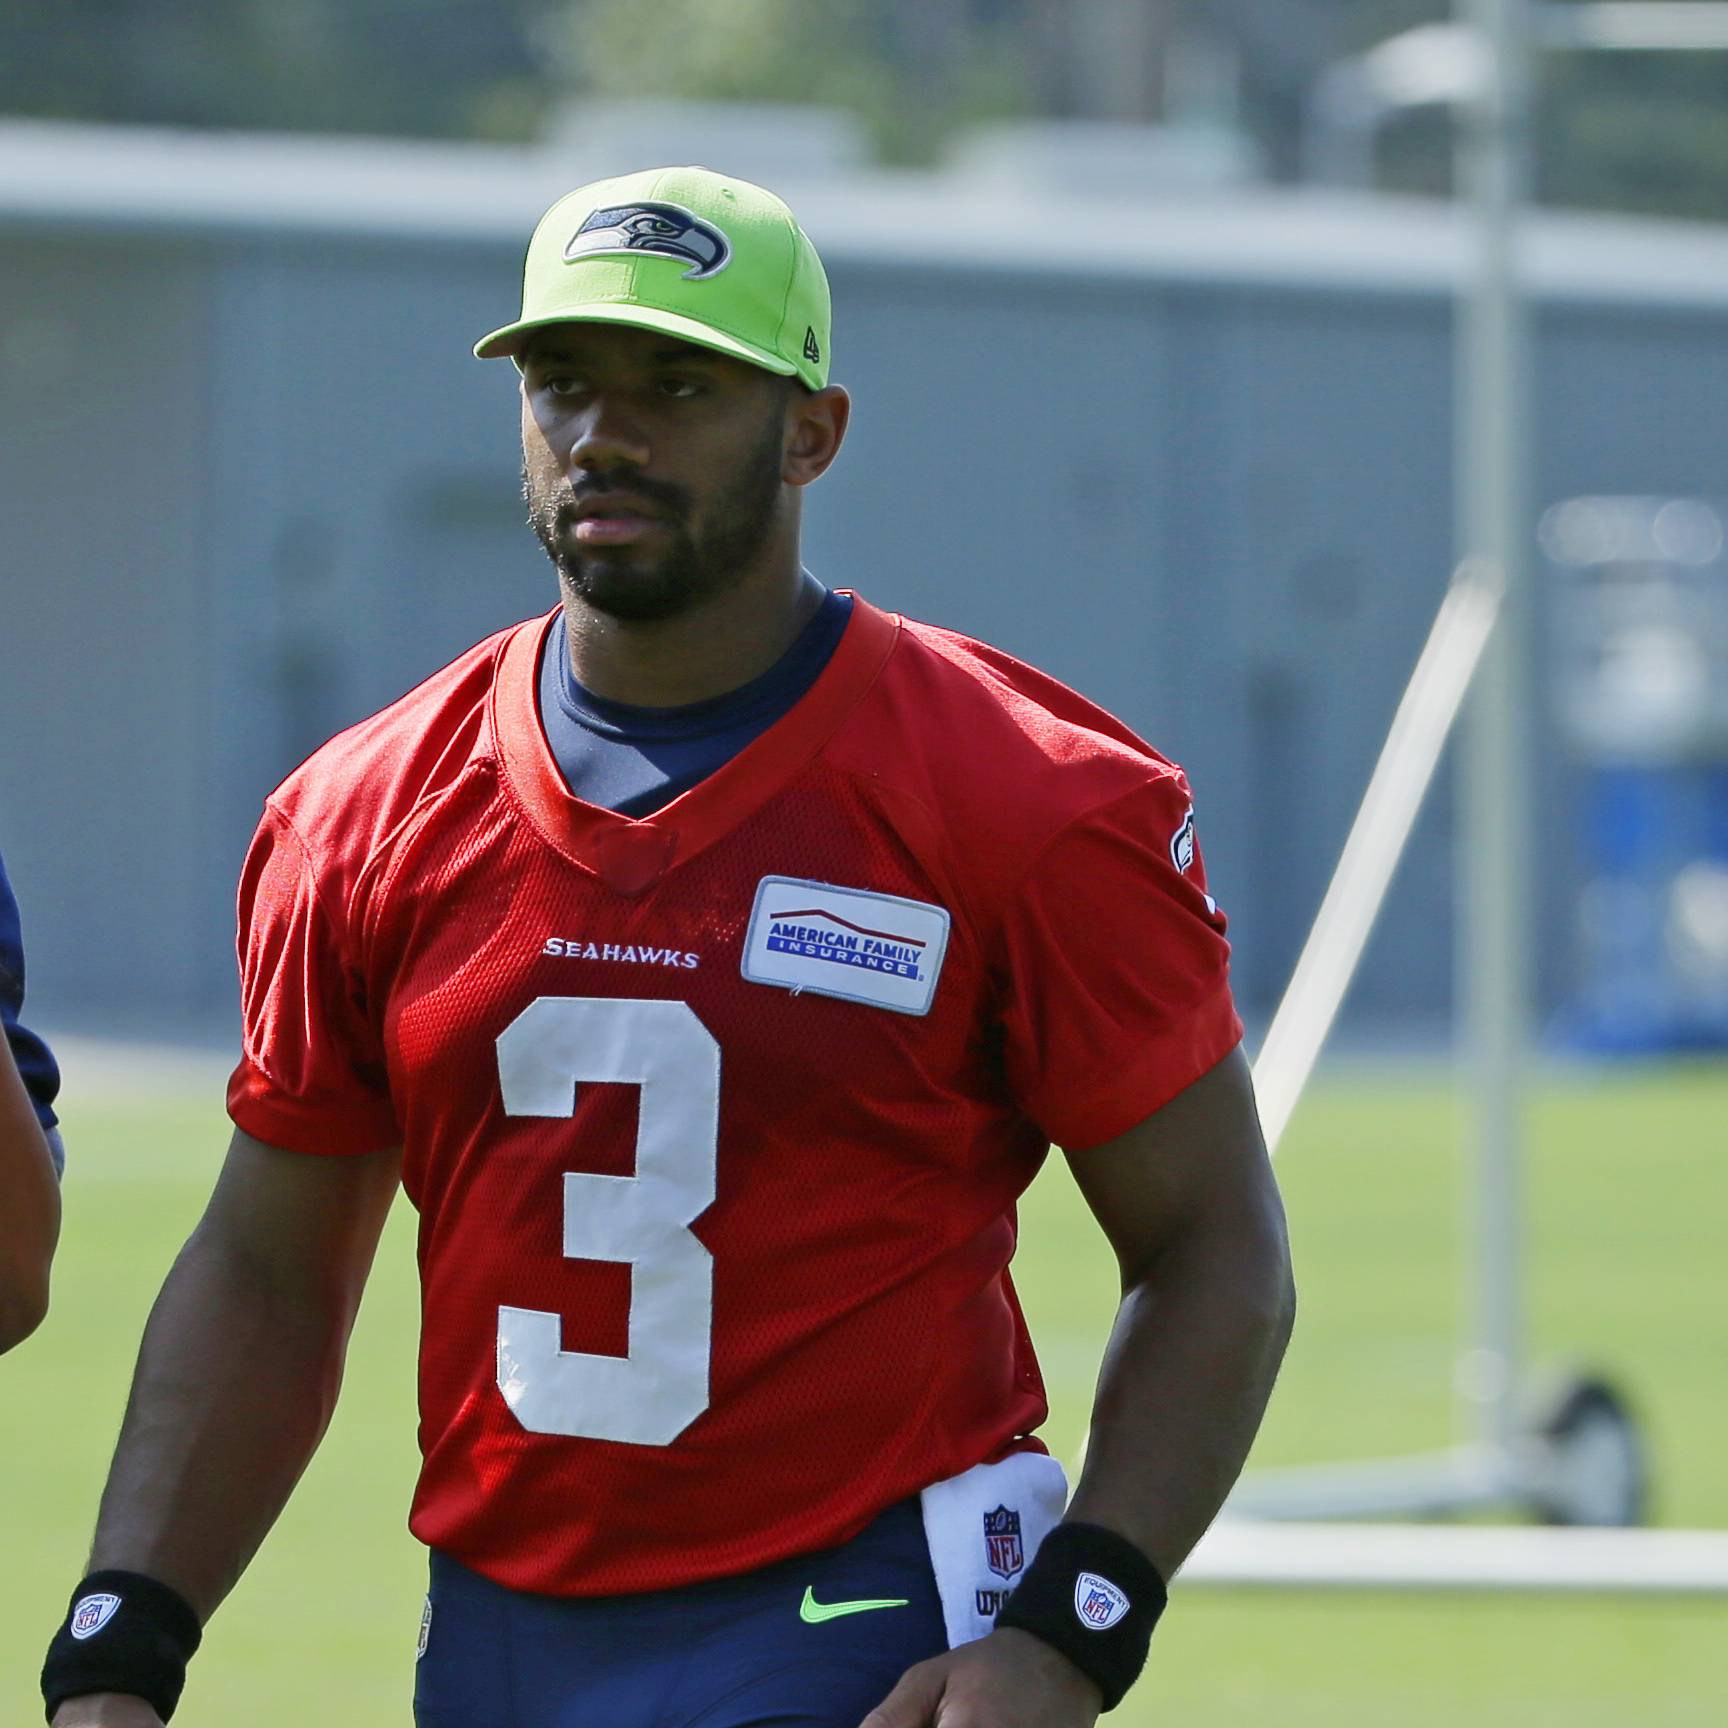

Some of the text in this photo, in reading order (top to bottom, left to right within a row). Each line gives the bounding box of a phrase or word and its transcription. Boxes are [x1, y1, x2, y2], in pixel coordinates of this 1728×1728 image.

[543, 937, 700, 969] SEAHAWKS
[770, 922, 922, 964] AMERICAN FAMILY
[778, 941, 909, 975] INSURANCE
[495, 996, 721, 1446] 3
[987, 1536, 1020, 1573] NFL
[1087, 1600, 1106, 1621] NFL
